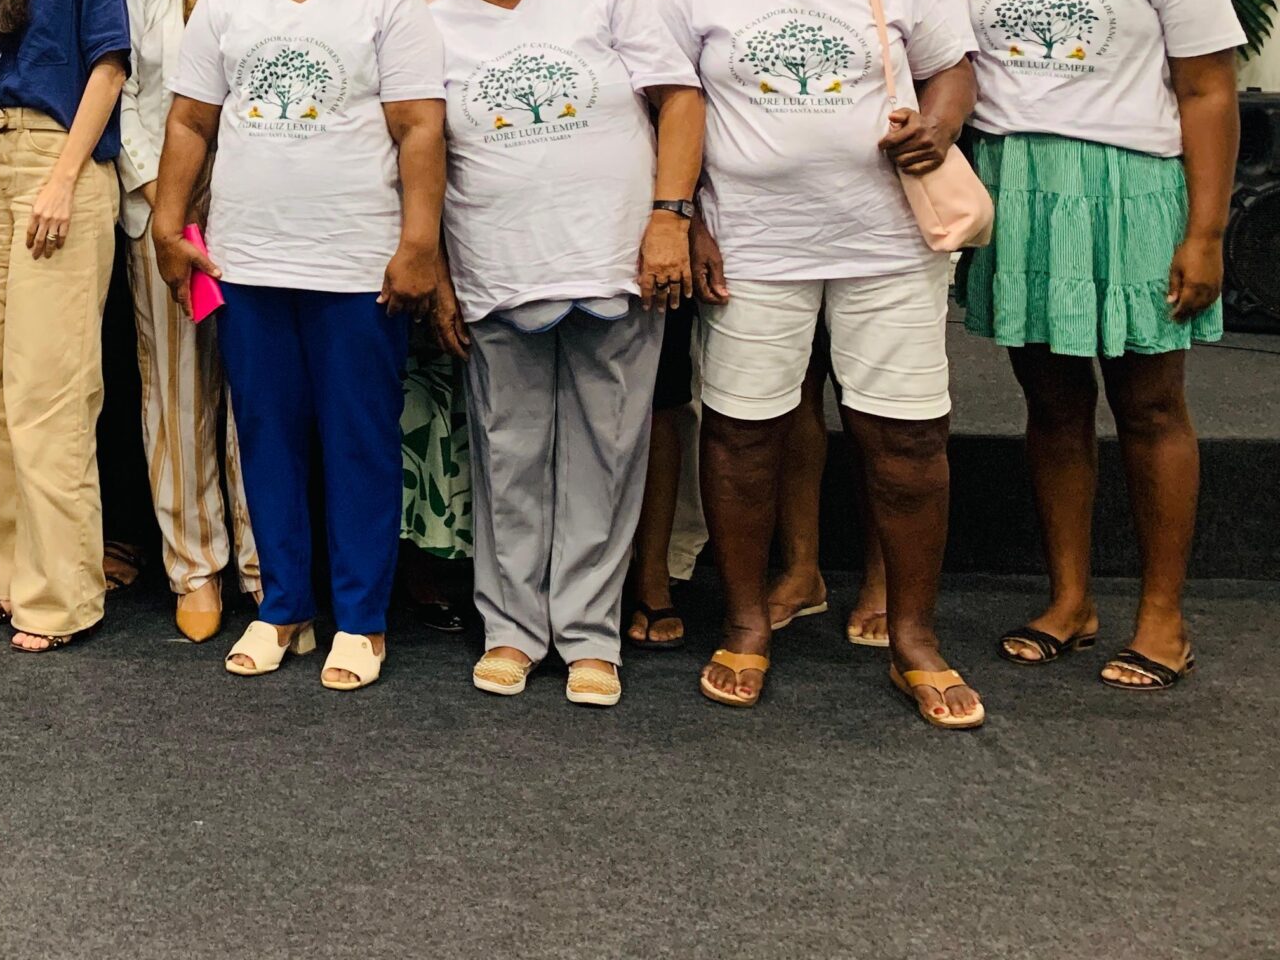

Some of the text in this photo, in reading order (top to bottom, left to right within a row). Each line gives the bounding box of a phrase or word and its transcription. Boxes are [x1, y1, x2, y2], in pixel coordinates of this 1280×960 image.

[745, 7, 798, 30] CATADORAS
[1027, 60, 1050, 69] LUIZ
[1052, 62, 1095, 73] LEMPER
[749, 97, 854, 106] PADRE LUIZ LEMPER
[286, 122, 327, 132] LEMPER
[483, 120, 589, 144] PADRE LUIZ LEMPER
